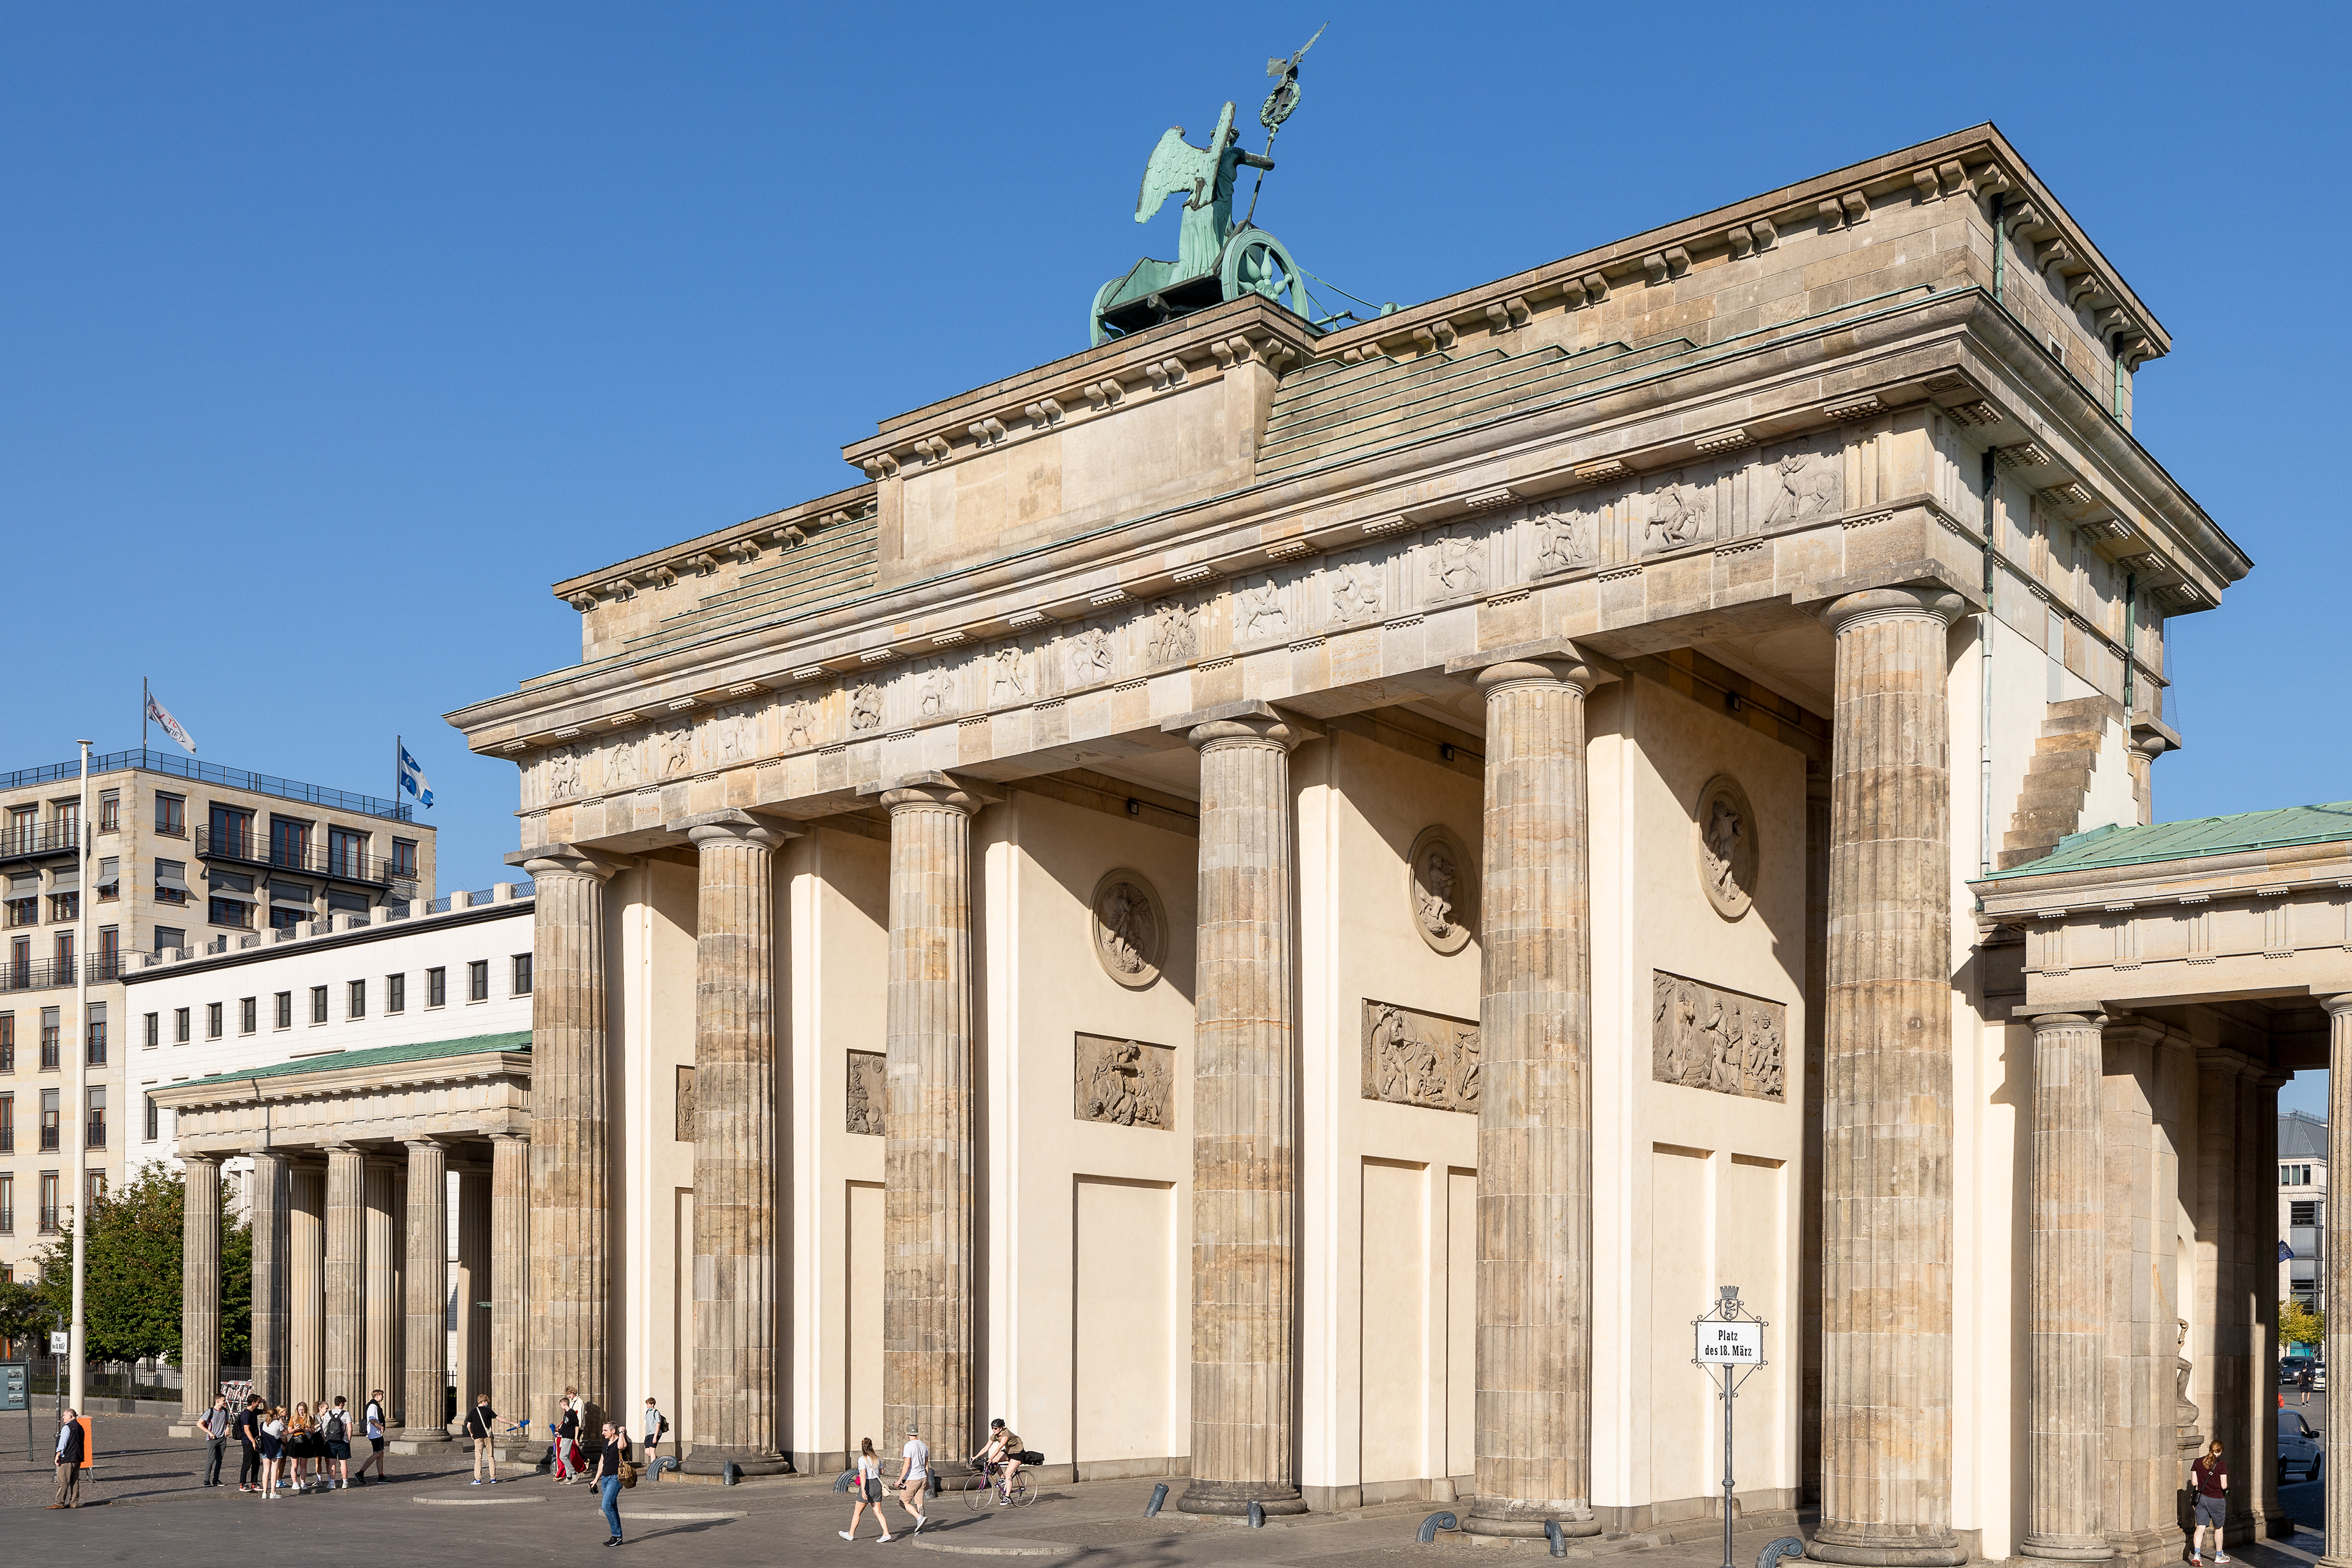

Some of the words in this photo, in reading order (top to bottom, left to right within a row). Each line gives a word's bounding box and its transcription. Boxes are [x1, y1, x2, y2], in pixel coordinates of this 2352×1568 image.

[164, 725, 184, 741] STIFT
[1718, 1330, 1738, 1341] Platz
[1705, 1344, 1718, 1355] des
[1720, 1345, 1730, 1356] 18.
[1732, 1345, 1752, 1356] März
